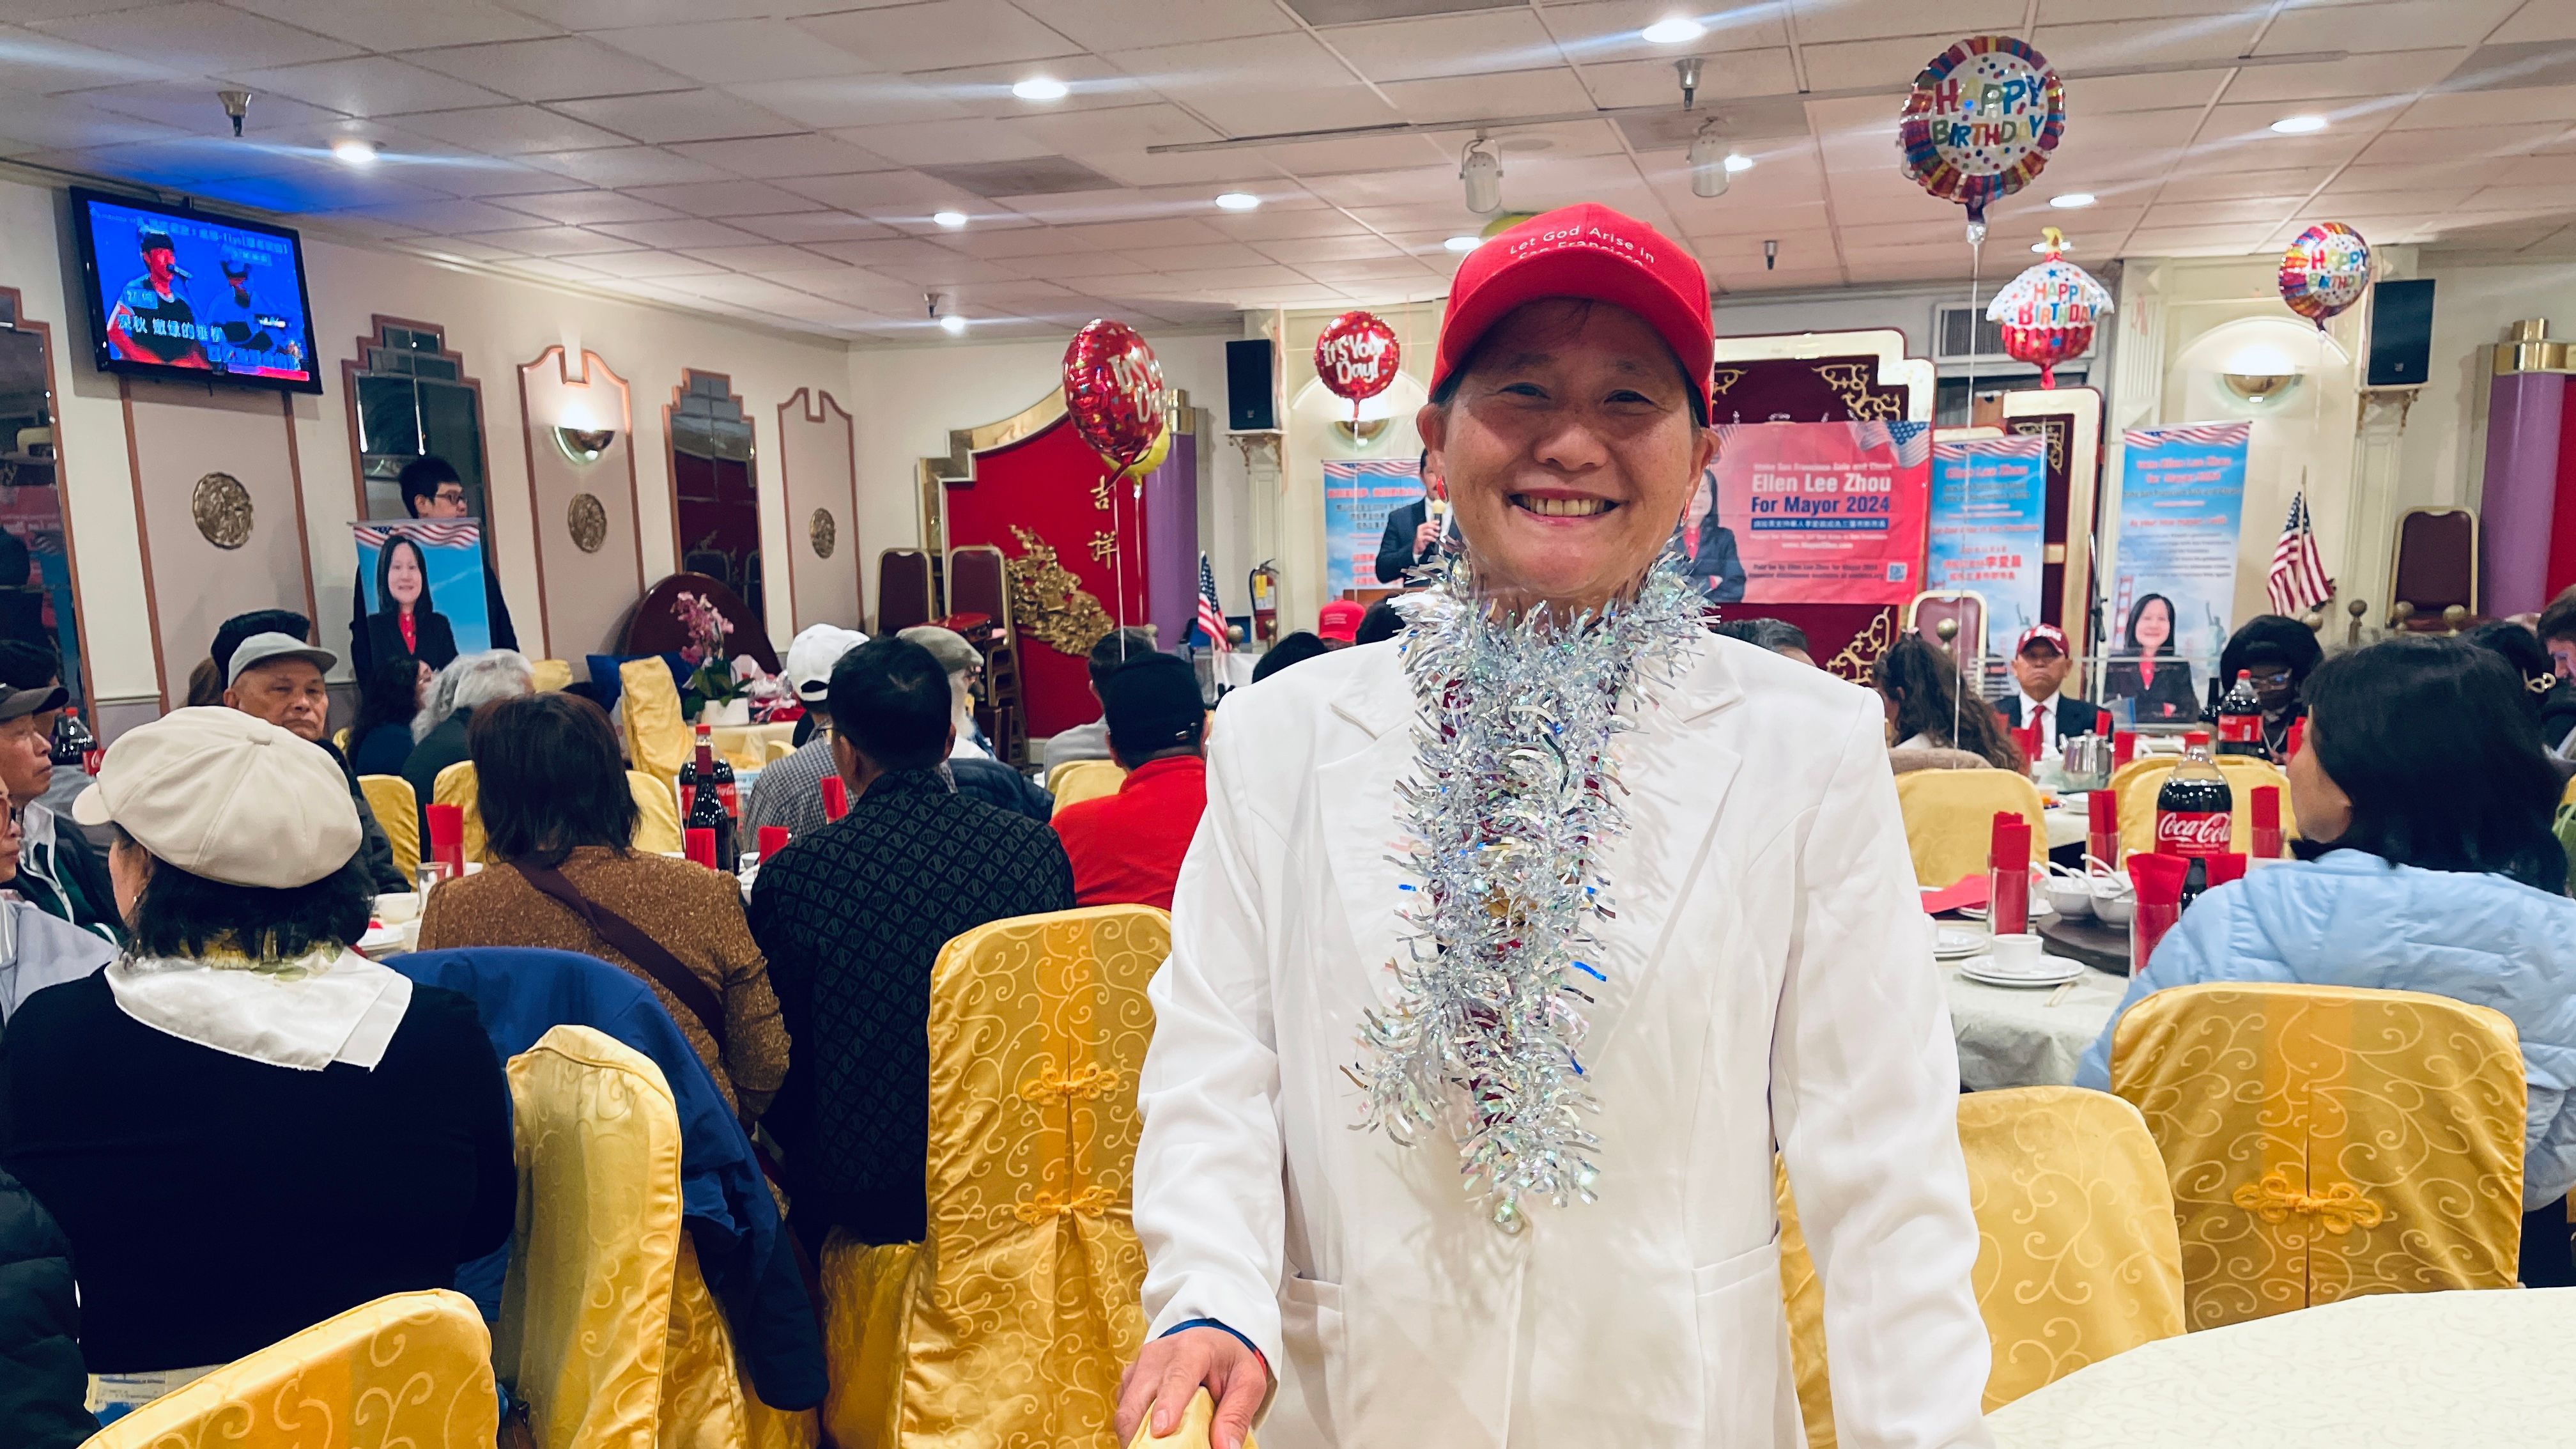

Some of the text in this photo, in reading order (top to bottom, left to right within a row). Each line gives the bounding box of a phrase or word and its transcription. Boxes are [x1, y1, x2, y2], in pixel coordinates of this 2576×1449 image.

[1934, 75, 2046, 117] HAPPY
[1932, 114, 2044, 148] BIRTHDAY
[1510, 237, 1536, 254] Let
[1543, 226, 1580, 242] God
[1589, 227, 1634, 250] Arise
[2033, 281, 2087, 302] HAPPY
[2017, 300, 2097, 325] BIRTHDAY
[1336, 355, 1380, 384] Day!
[1752, 473, 1891, 492] Ellen Lee Zhou
[1751, 495, 1890, 516] For Mayor 2024
